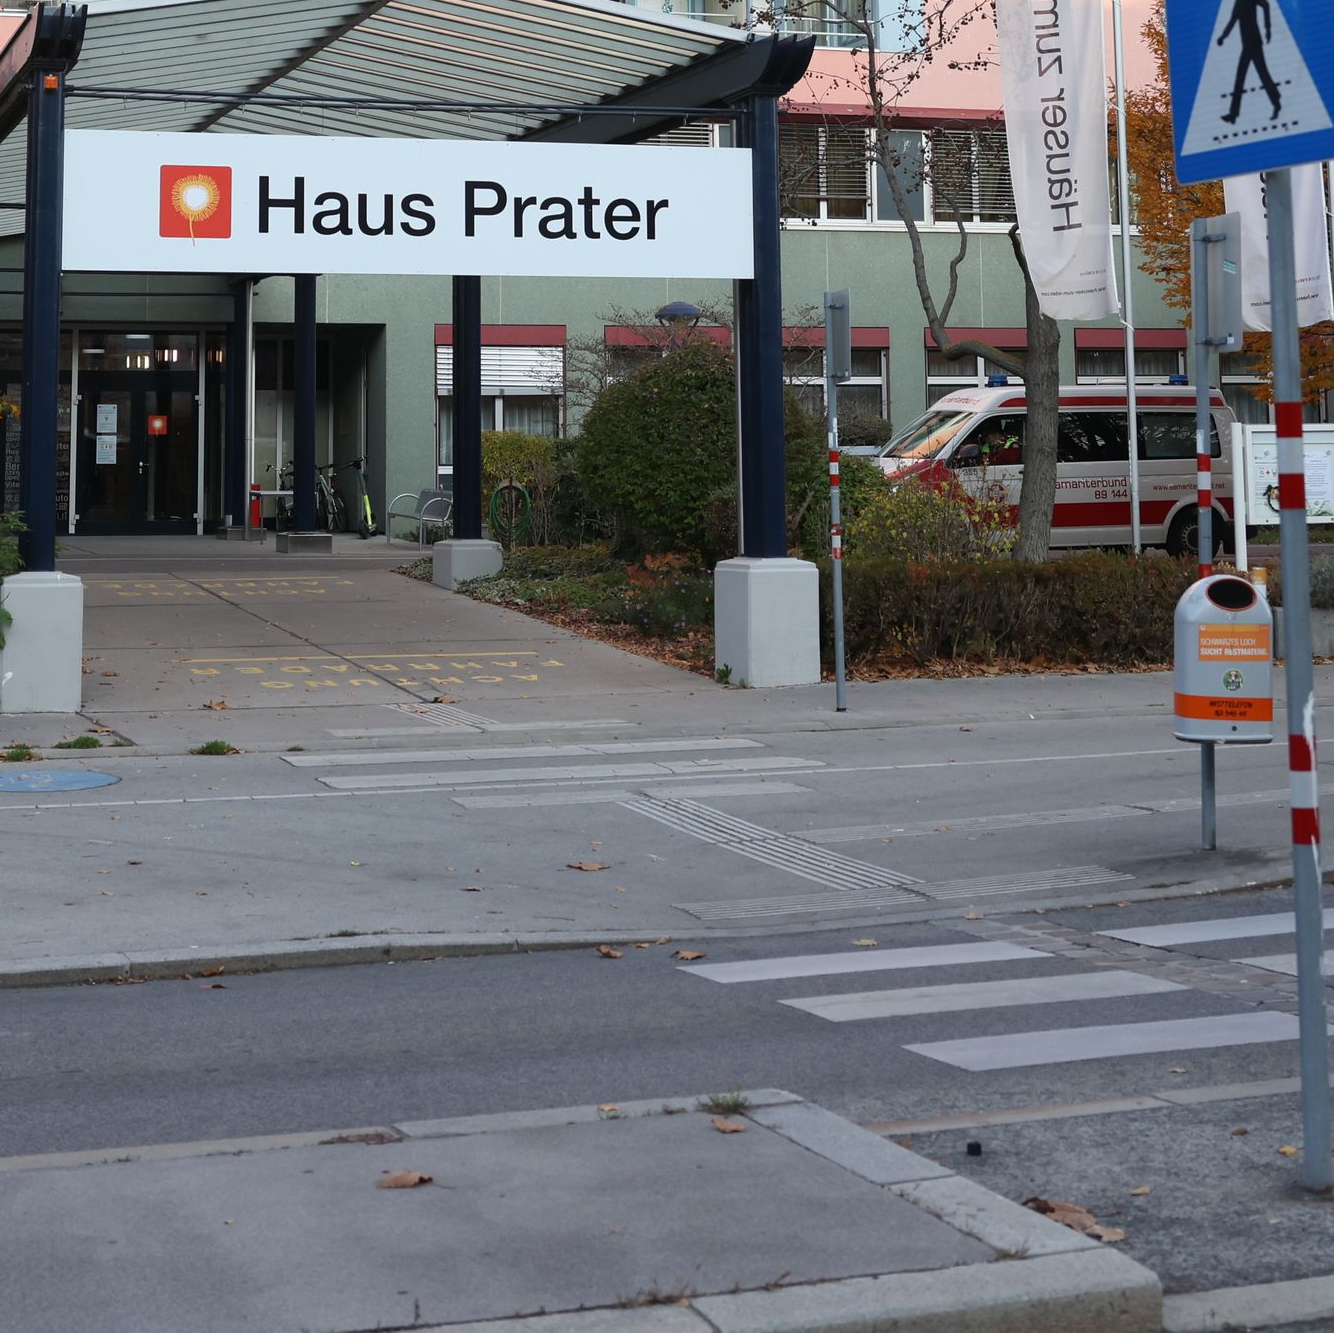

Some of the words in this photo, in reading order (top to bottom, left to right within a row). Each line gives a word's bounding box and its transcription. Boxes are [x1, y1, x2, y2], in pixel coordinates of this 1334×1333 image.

[258, 174, 435, 237] Haus
[465, 180, 669, 241] Prater
[1054, 476, 1128, 490] amariterbund
[1094, 489, 1108, 500] 89
[1112, 488, 1128, 499] 144
[260, 674, 539, 689] ACHTUNG
